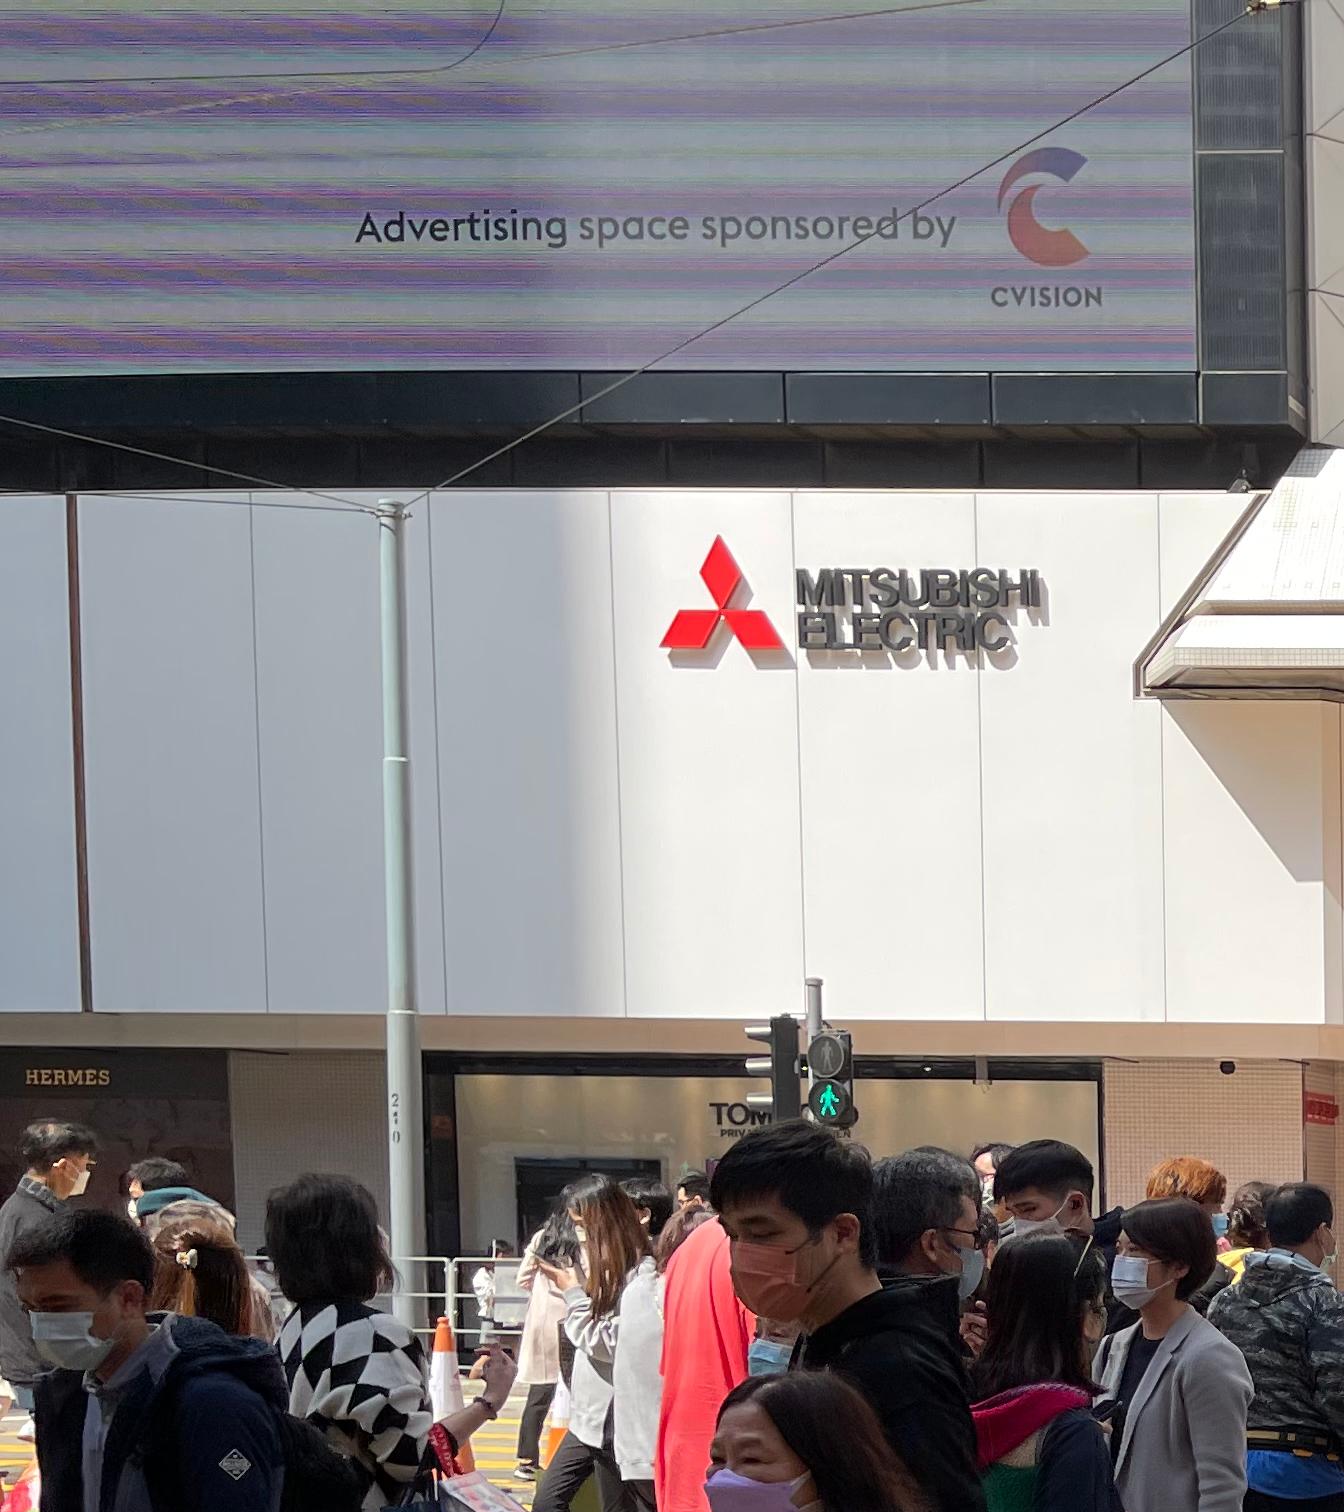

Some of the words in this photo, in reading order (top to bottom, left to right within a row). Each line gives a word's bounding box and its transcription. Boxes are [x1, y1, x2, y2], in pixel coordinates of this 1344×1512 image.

[355, 211, 567, 248] Advertising
[578, 213, 690, 248] space
[702, 209, 898, 248] sponsored
[912, 208, 958, 247] by
[991, 287, 1102, 308] CVISION
[795, 567, 1041, 608] MITSUBISHI
[797, 611, 1011, 651] ELECTRIC
